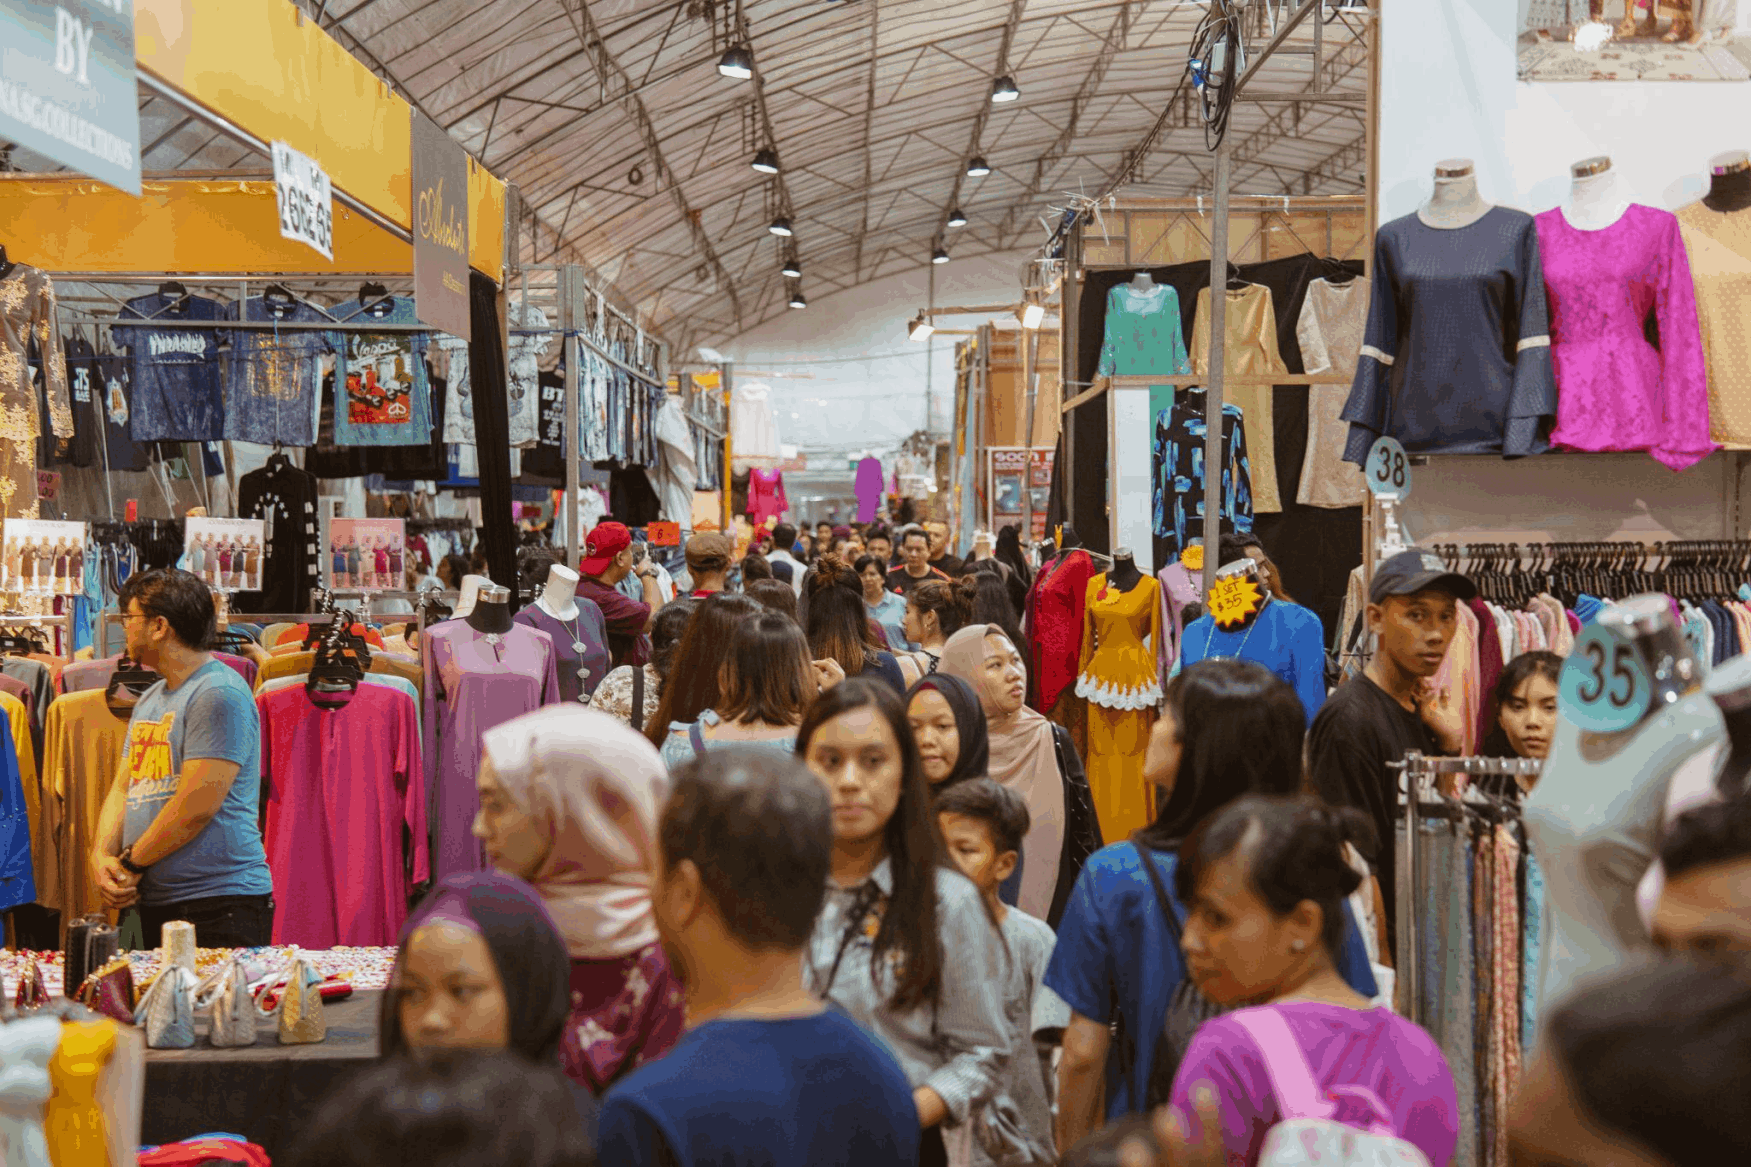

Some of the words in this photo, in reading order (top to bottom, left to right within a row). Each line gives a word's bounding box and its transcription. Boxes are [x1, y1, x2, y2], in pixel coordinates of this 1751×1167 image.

[56, 6, 93, 84] BY
[1376, 446, 1405, 488] 38
[1223, 580, 1240, 596] SET
[1579, 639, 1635, 708] 35
